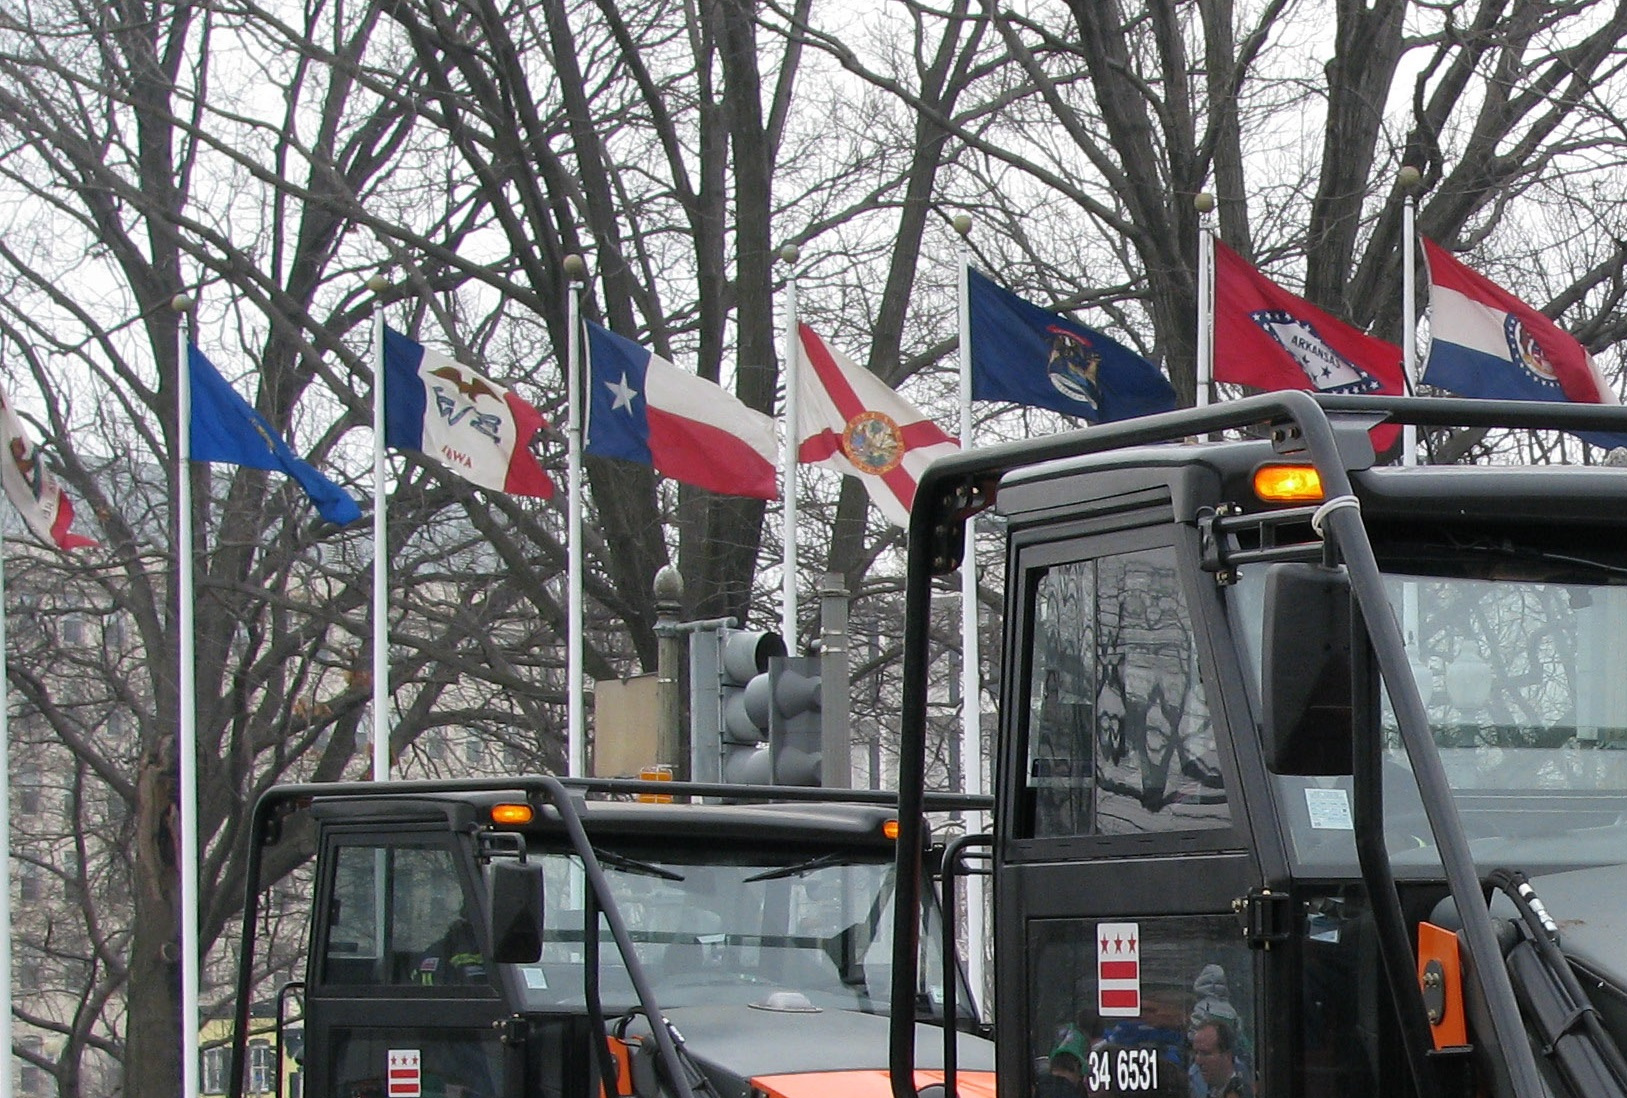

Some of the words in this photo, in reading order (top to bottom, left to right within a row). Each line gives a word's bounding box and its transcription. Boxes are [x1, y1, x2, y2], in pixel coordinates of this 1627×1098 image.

[441, 445, 473, 468] IOWA
[1088, 1051, 1111, 1092] 34
[1117, 1049, 1158, 1091] 6531
